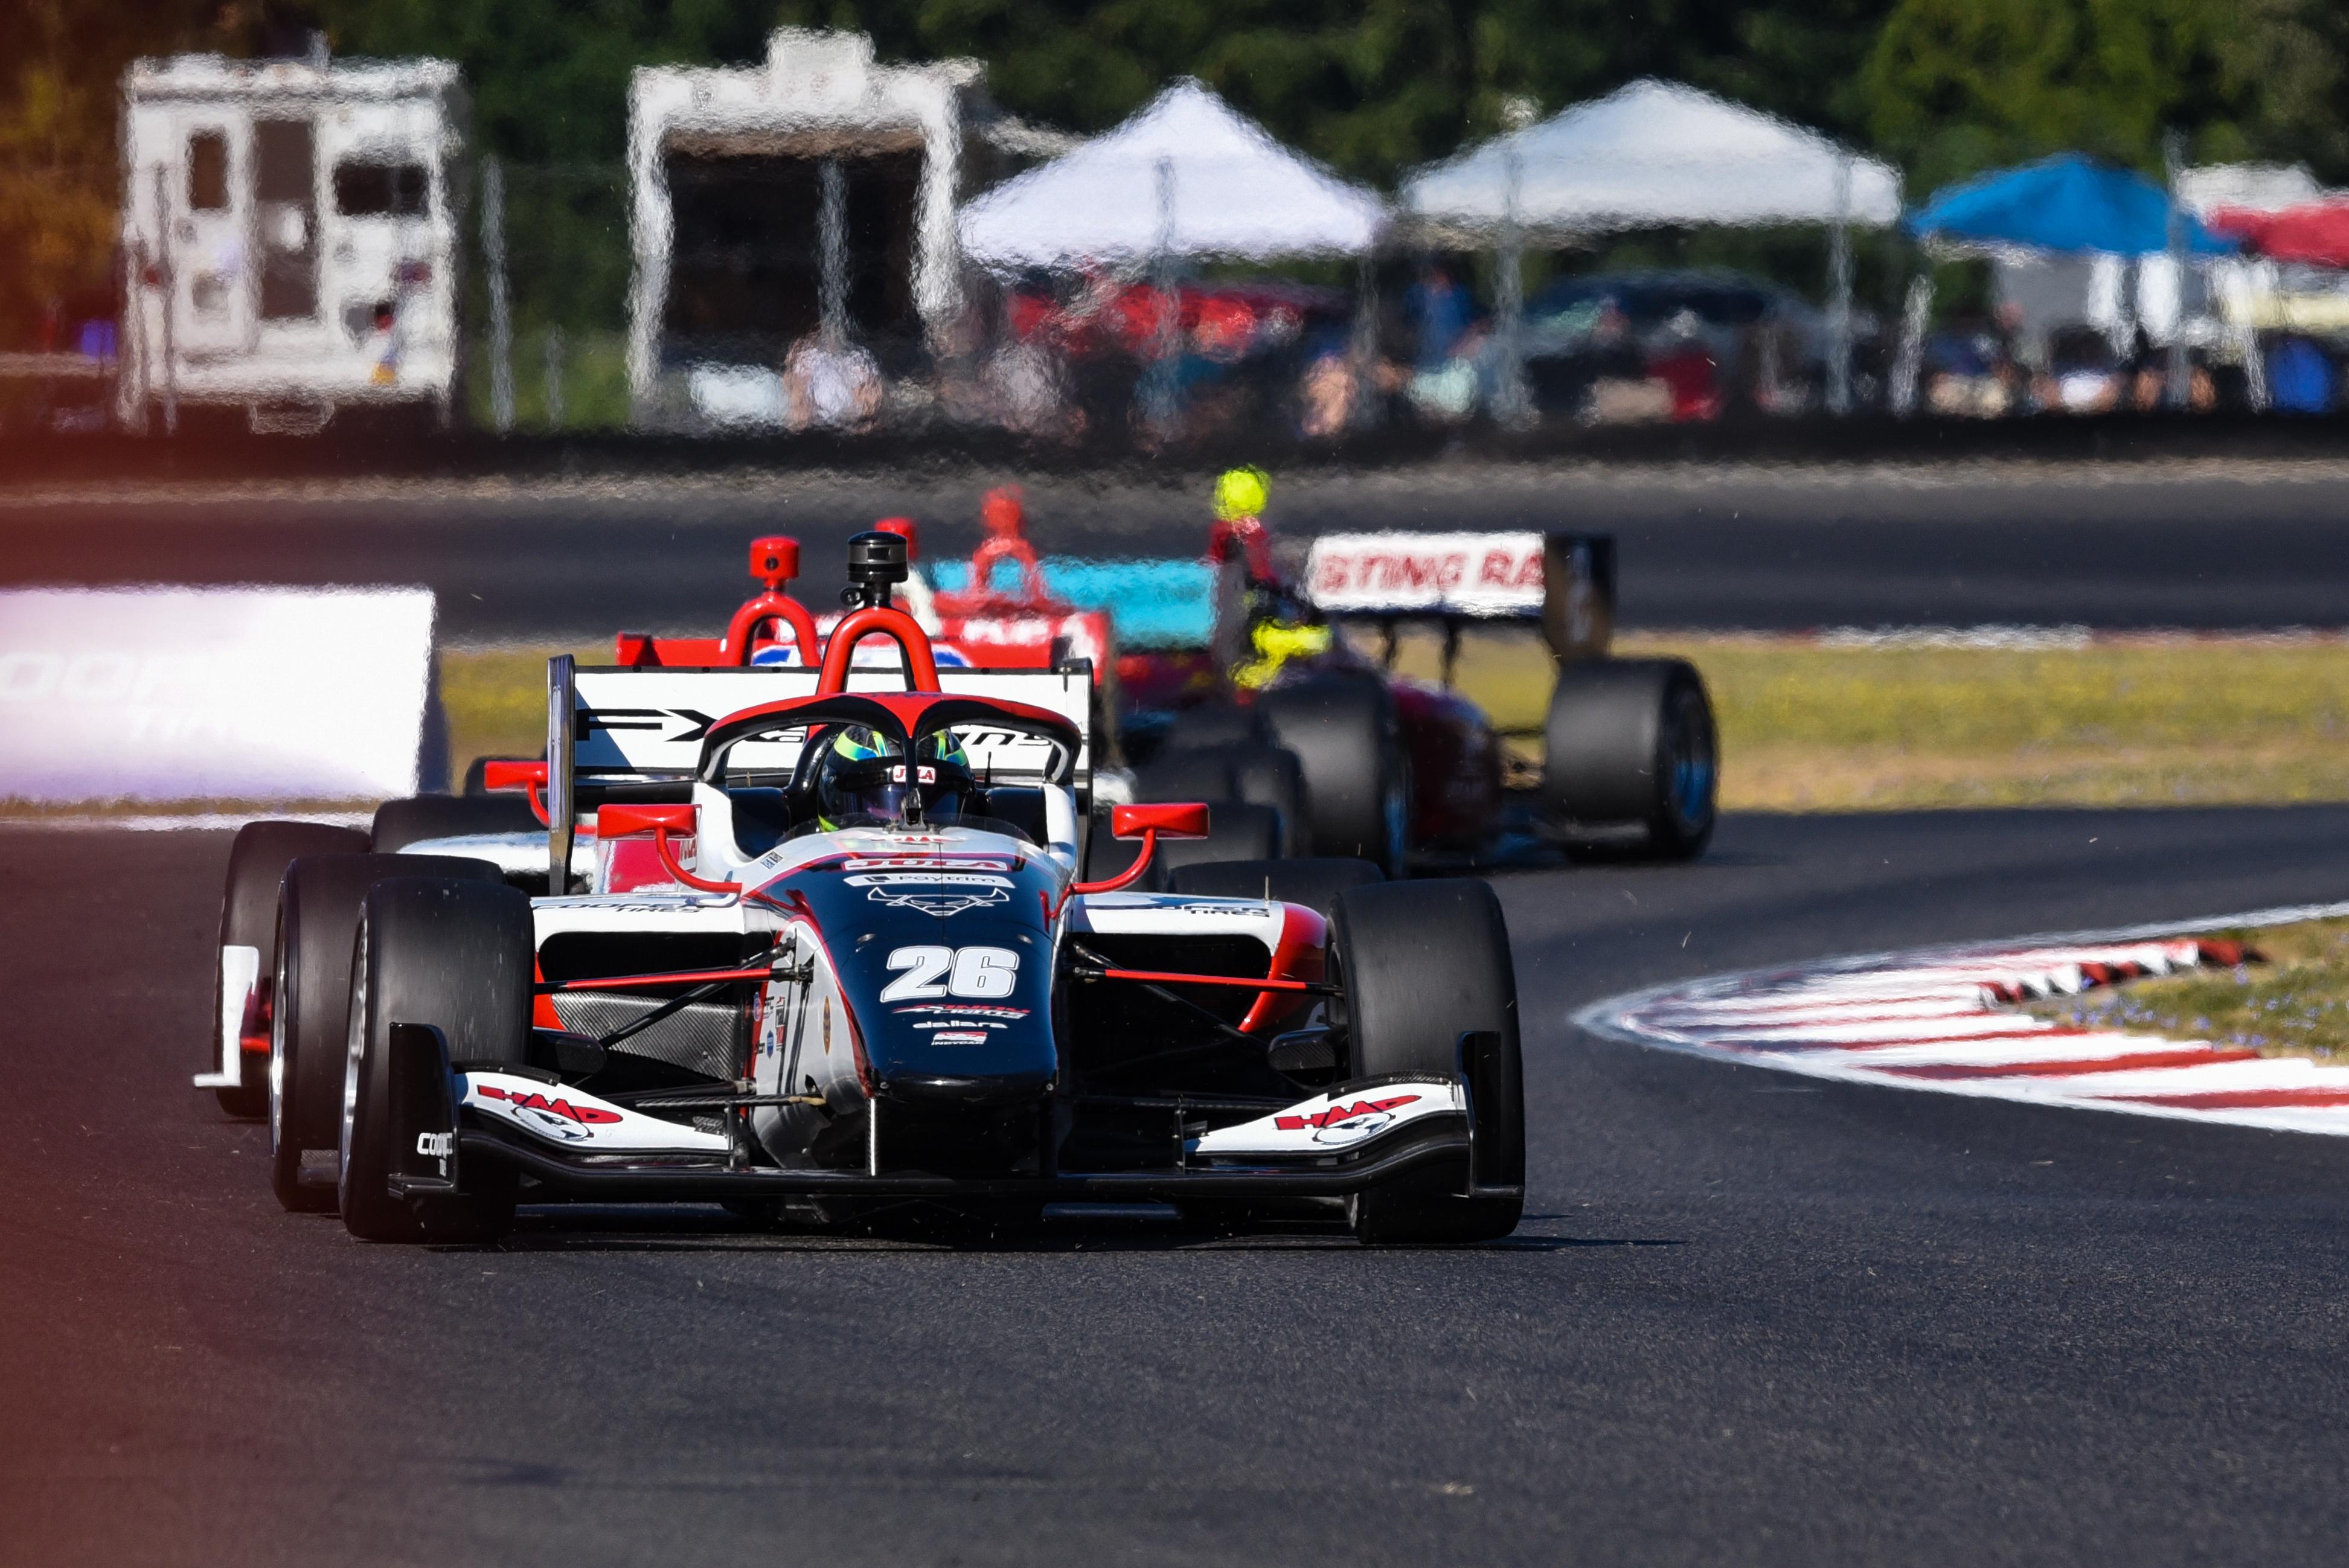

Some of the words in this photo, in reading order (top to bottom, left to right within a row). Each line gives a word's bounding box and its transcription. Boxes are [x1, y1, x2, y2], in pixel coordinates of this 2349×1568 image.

[1316, 553, 1467, 594] STING
[894, 767, 935, 781] JLA
[848, 860, 1007, 869] JULA
[898, 875, 996, 884] Paytrim
[880, 945, 1020, 1003] 26
[912, 1020, 1008, 1029] dallara
[476, 1084, 623, 1124] HMD
[1274, 1094, 1422, 1130] HMD
